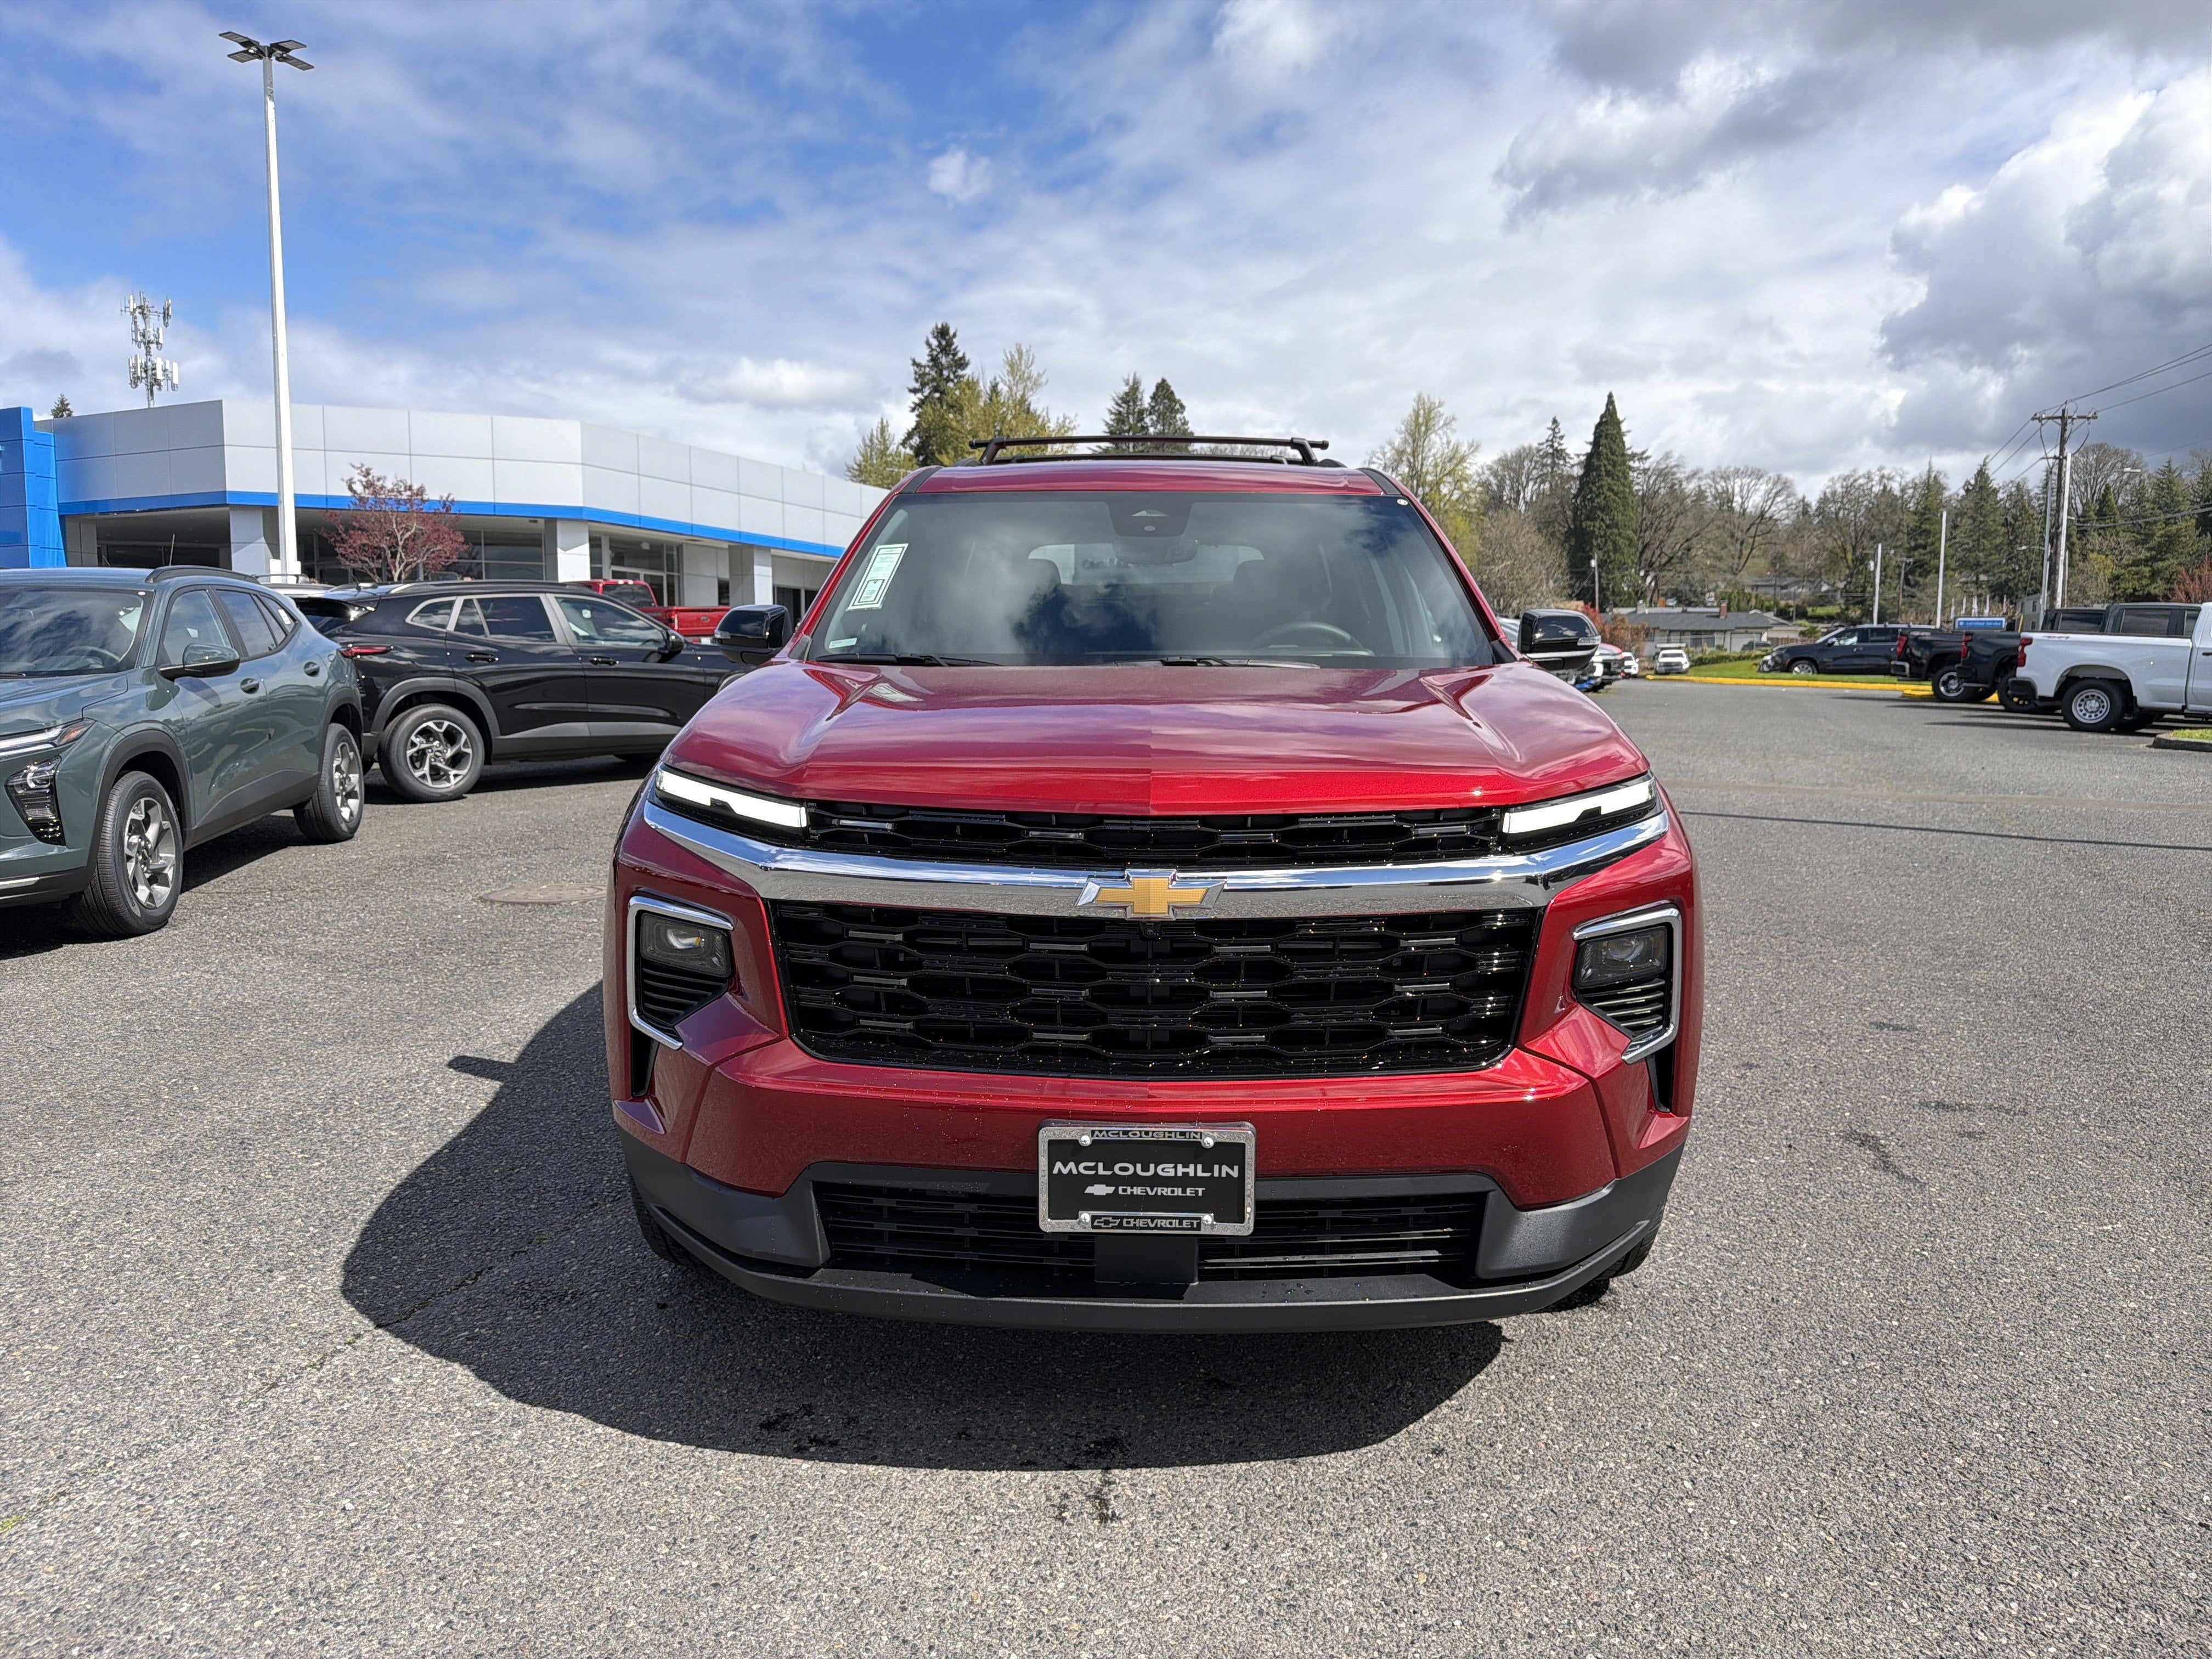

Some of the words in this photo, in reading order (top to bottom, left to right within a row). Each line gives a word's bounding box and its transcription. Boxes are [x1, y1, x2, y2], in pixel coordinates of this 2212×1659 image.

[1093, 1130, 1201, 1139] MCLOUGHLIN
[1052, 1161, 1239, 1178] MCLOUGHLIN
[1118, 1186, 1205, 1197] CHEVROLET
[1122, 1218, 1200, 1228] CHEVROLET
